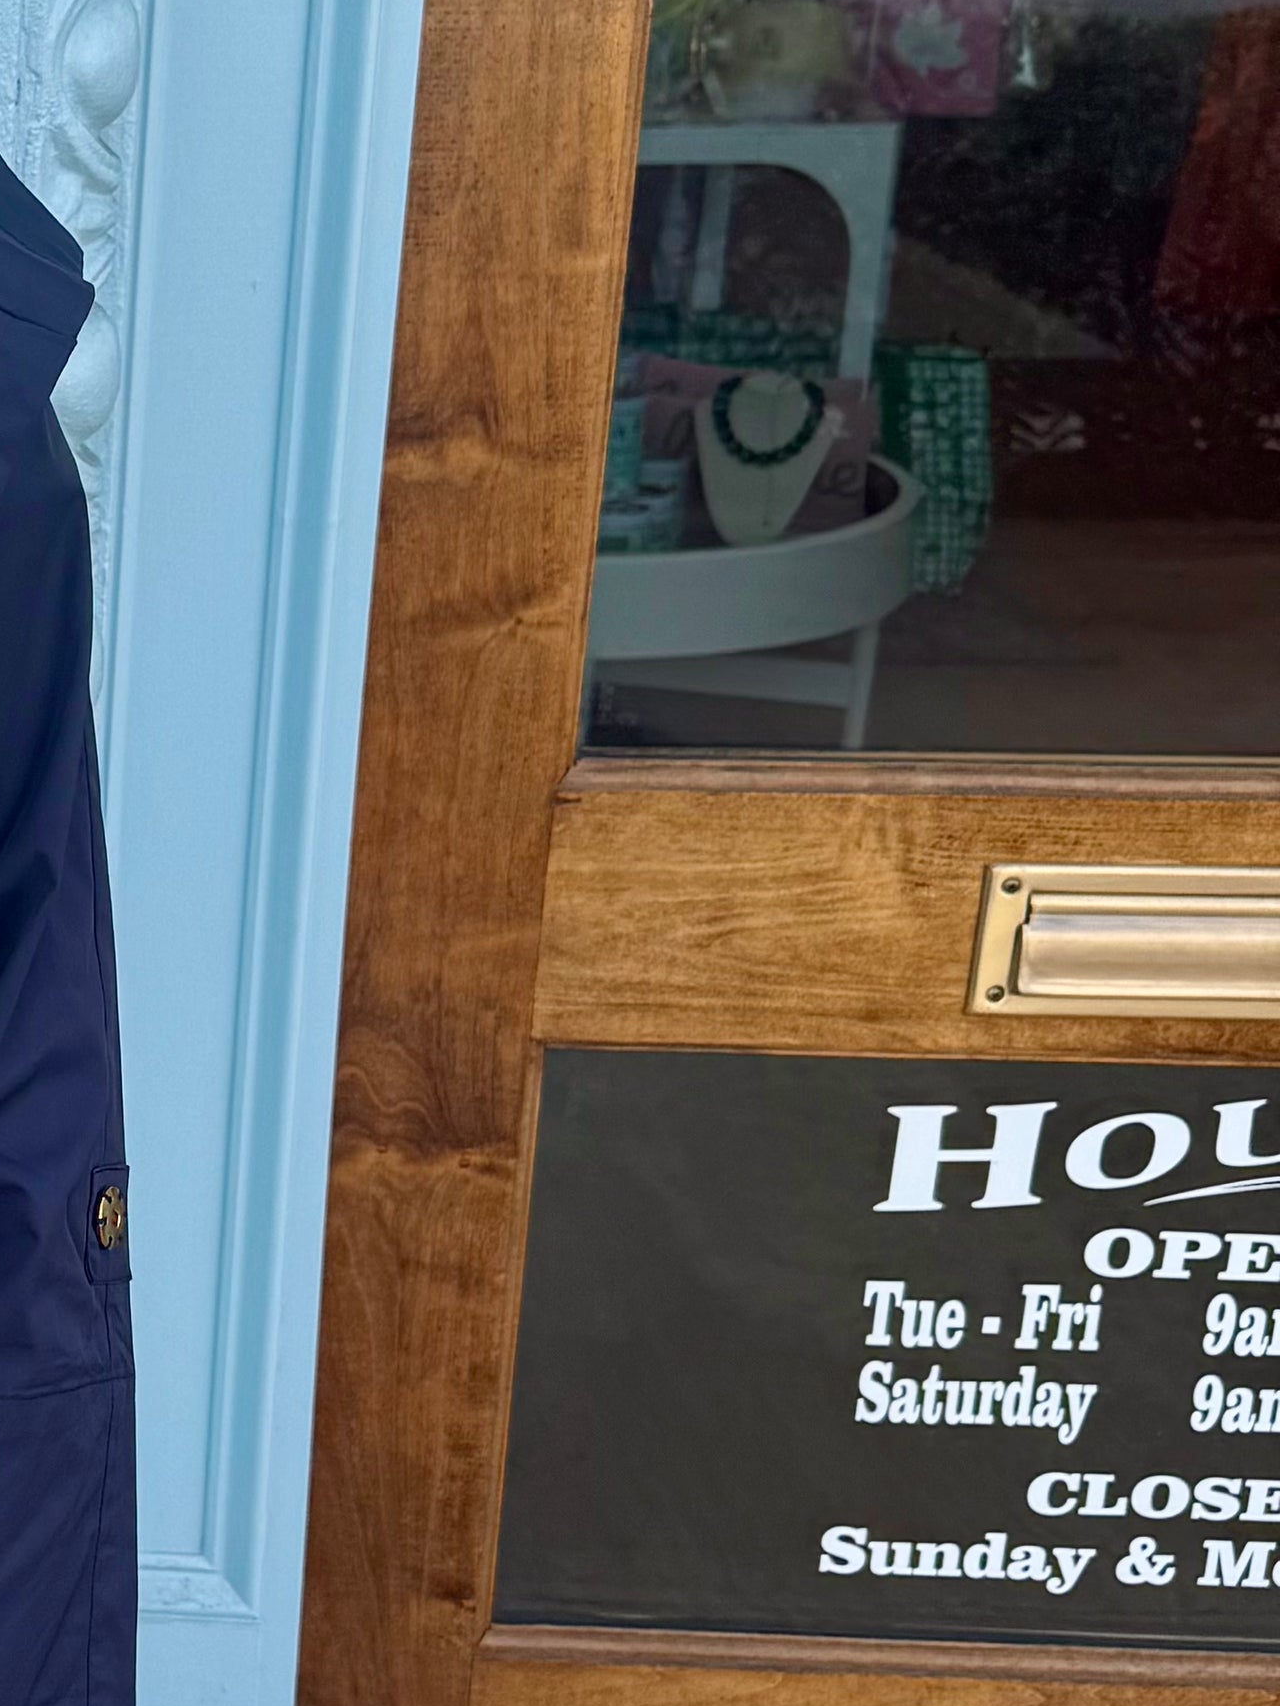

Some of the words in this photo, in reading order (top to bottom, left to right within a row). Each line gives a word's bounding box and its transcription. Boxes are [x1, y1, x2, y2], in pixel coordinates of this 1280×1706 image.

[862, 1280, 967, 1350] Tue
[1013, 1283, 1103, 1352] Fri
[1202, 1293, 1280, 1358] 9a
[854, 1360, 1098, 1446] Saturday
[819, 1525, 1097, 1595] Sunday
[1115, 1536, 1176, 1586] &
[1196, 1539, 1280, 1588] M
